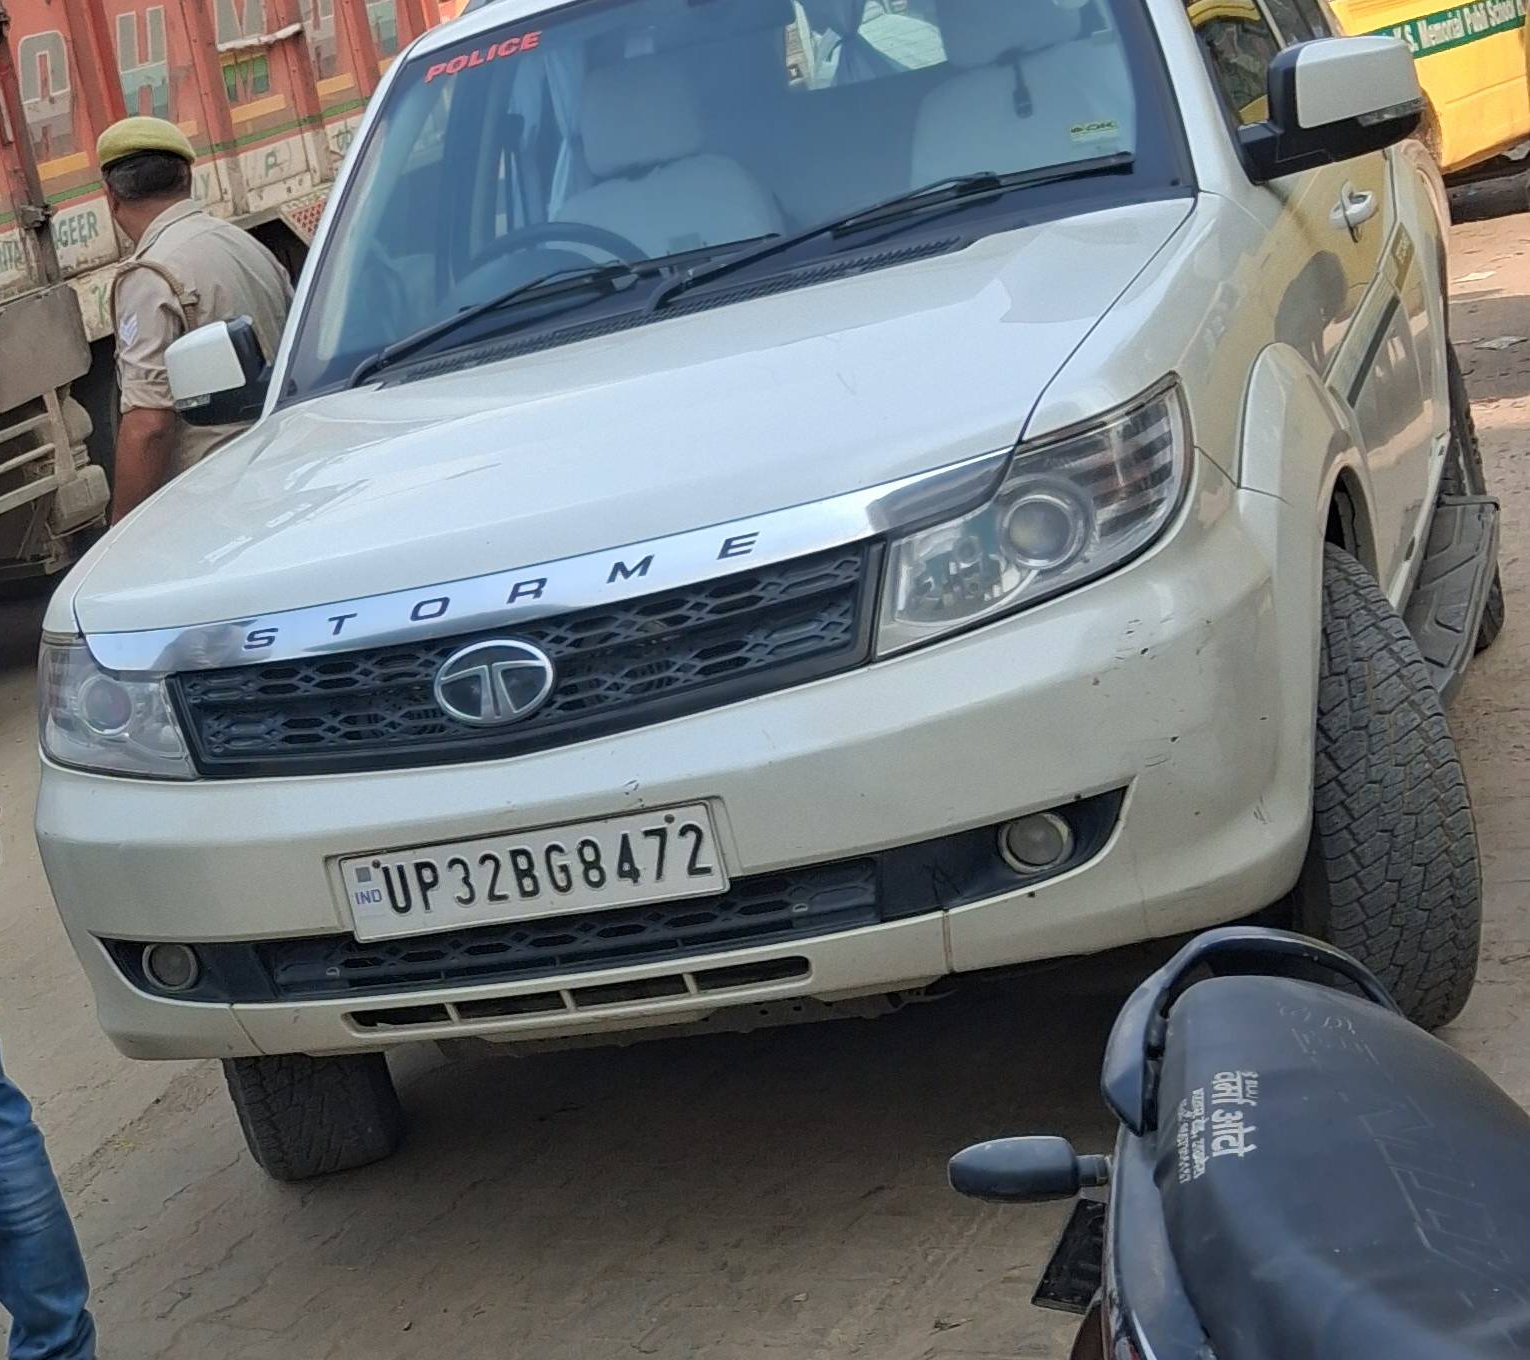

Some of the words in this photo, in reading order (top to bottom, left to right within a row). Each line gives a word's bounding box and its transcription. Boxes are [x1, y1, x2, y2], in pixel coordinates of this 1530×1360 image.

[424, 30, 543, 83] POLICE
[243, 531, 760, 652] STORME
[354, 890, 383, 906] IND
[381, 823, 713, 914] UP32BG8472
